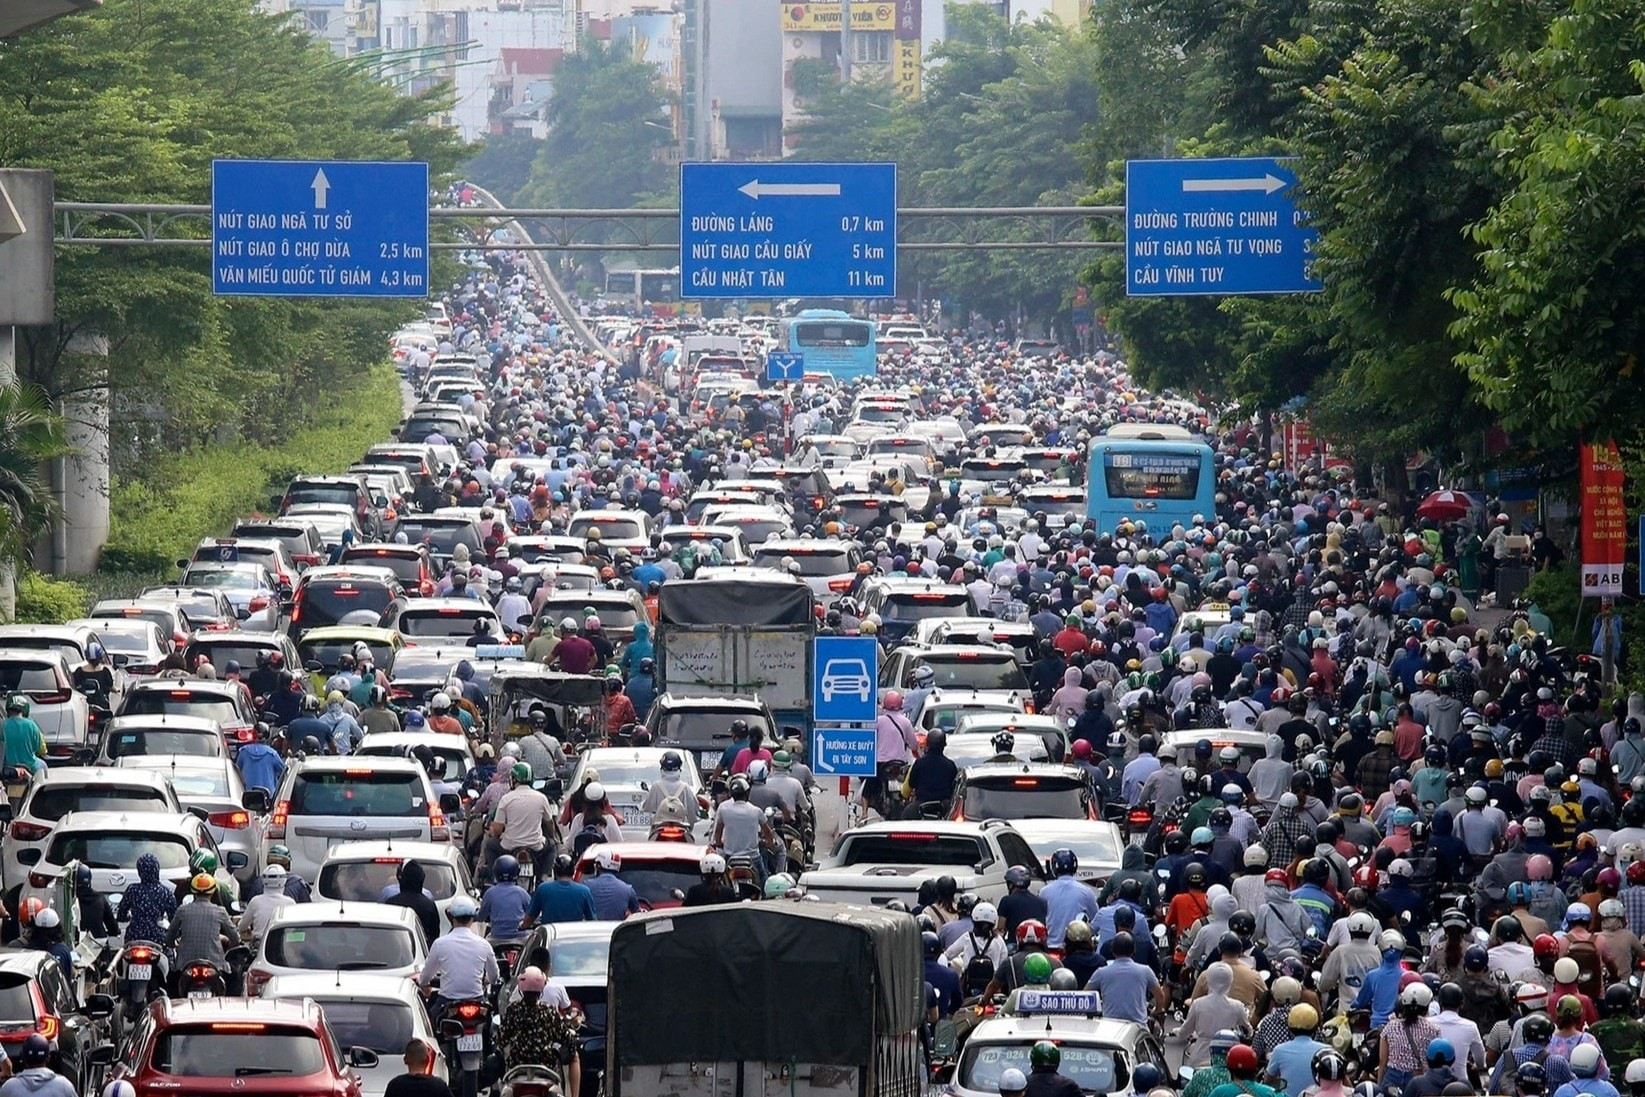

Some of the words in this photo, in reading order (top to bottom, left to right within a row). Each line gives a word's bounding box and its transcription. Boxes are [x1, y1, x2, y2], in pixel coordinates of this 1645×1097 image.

[219, 209, 243, 229] NÚT
[248, 214, 276, 229] GIAO
[281, 211, 307, 229] NGÃ
[313, 214, 329, 230] TƯ
[335, 210, 352, 230] SỞ
[691, 211, 735, 232] ĐƯỜNG
[740, 211, 773, 232] LÁNG
[865, 216, 884, 232] km
[1134, 208, 1177, 229] ĐƯỜNG
[1183, 207, 1234, 228] TRƯỜNG
[1239, 211, 1277, 228] CHINH
[219, 237, 243, 256] NÚT
[248, 241, 276, 256] GIAO
[281, 239, 289, 257] Ô
[295, 241, 320, 260] CHỢ
[325, 238, 350, 257] DỪA
[403, 243, 422, 258] km
[692, 239, 716, 259] NÚT
[721, 244, 749, 259] GIAO
[755, 239, 779, 259] CẦU
[784, 239, 812, 259] GIẤY
[853, 244, 860, 259] 5
[865, 244, 884, 259] km
[1135, 237, 1160, 256] NÚT
[1163, 241, 1192, 256] GIAO
[1196, 237, 1221, 255] NGÃ
[1227, 239, 1243, 255] TƯ
[1249, 239, 1282, 257] VỌNG
[220, 266, 244, 283] VĂN
[248, 264, 278, 284] MIẾU
[282, 264, 315, 285] QUỐC
[320, 265, 335, 285] TỬ
[340, 265, 371, 285] GIÁM
[403, 270, 422, 286] km
[692, 267, 716, 286] CẦU
[722, 268, 754, 288] NHẬT
[760, 268, 785, 286] TÂN
[848, 271, 860, 286] 11
[865, 271, 884, 286] km
[1135, 263, 1159, 284] CẦU
[1165, 265, 1194, 283] VĨNH
[1200, 267, 1224, 283] TUY
[825, 739, 847, 750] HƯỚNG
[848, 741, 857, 750] XE
[857, 739, 874, 751] BUÝT
[832, 755, 840, 764] ĐI
[841, 753, 852, 764] TÂY
[853, 755, 867, 765] SƠN
[1041, 997, 1058, 1009] SAO
[1061, 995, 1076, 1009] THỦ
[1079, 996, 1090, 1009] ĐÔ
[984, 1052, 998, 1061] 723
[1006, 1051, 1024, 1060] 024
